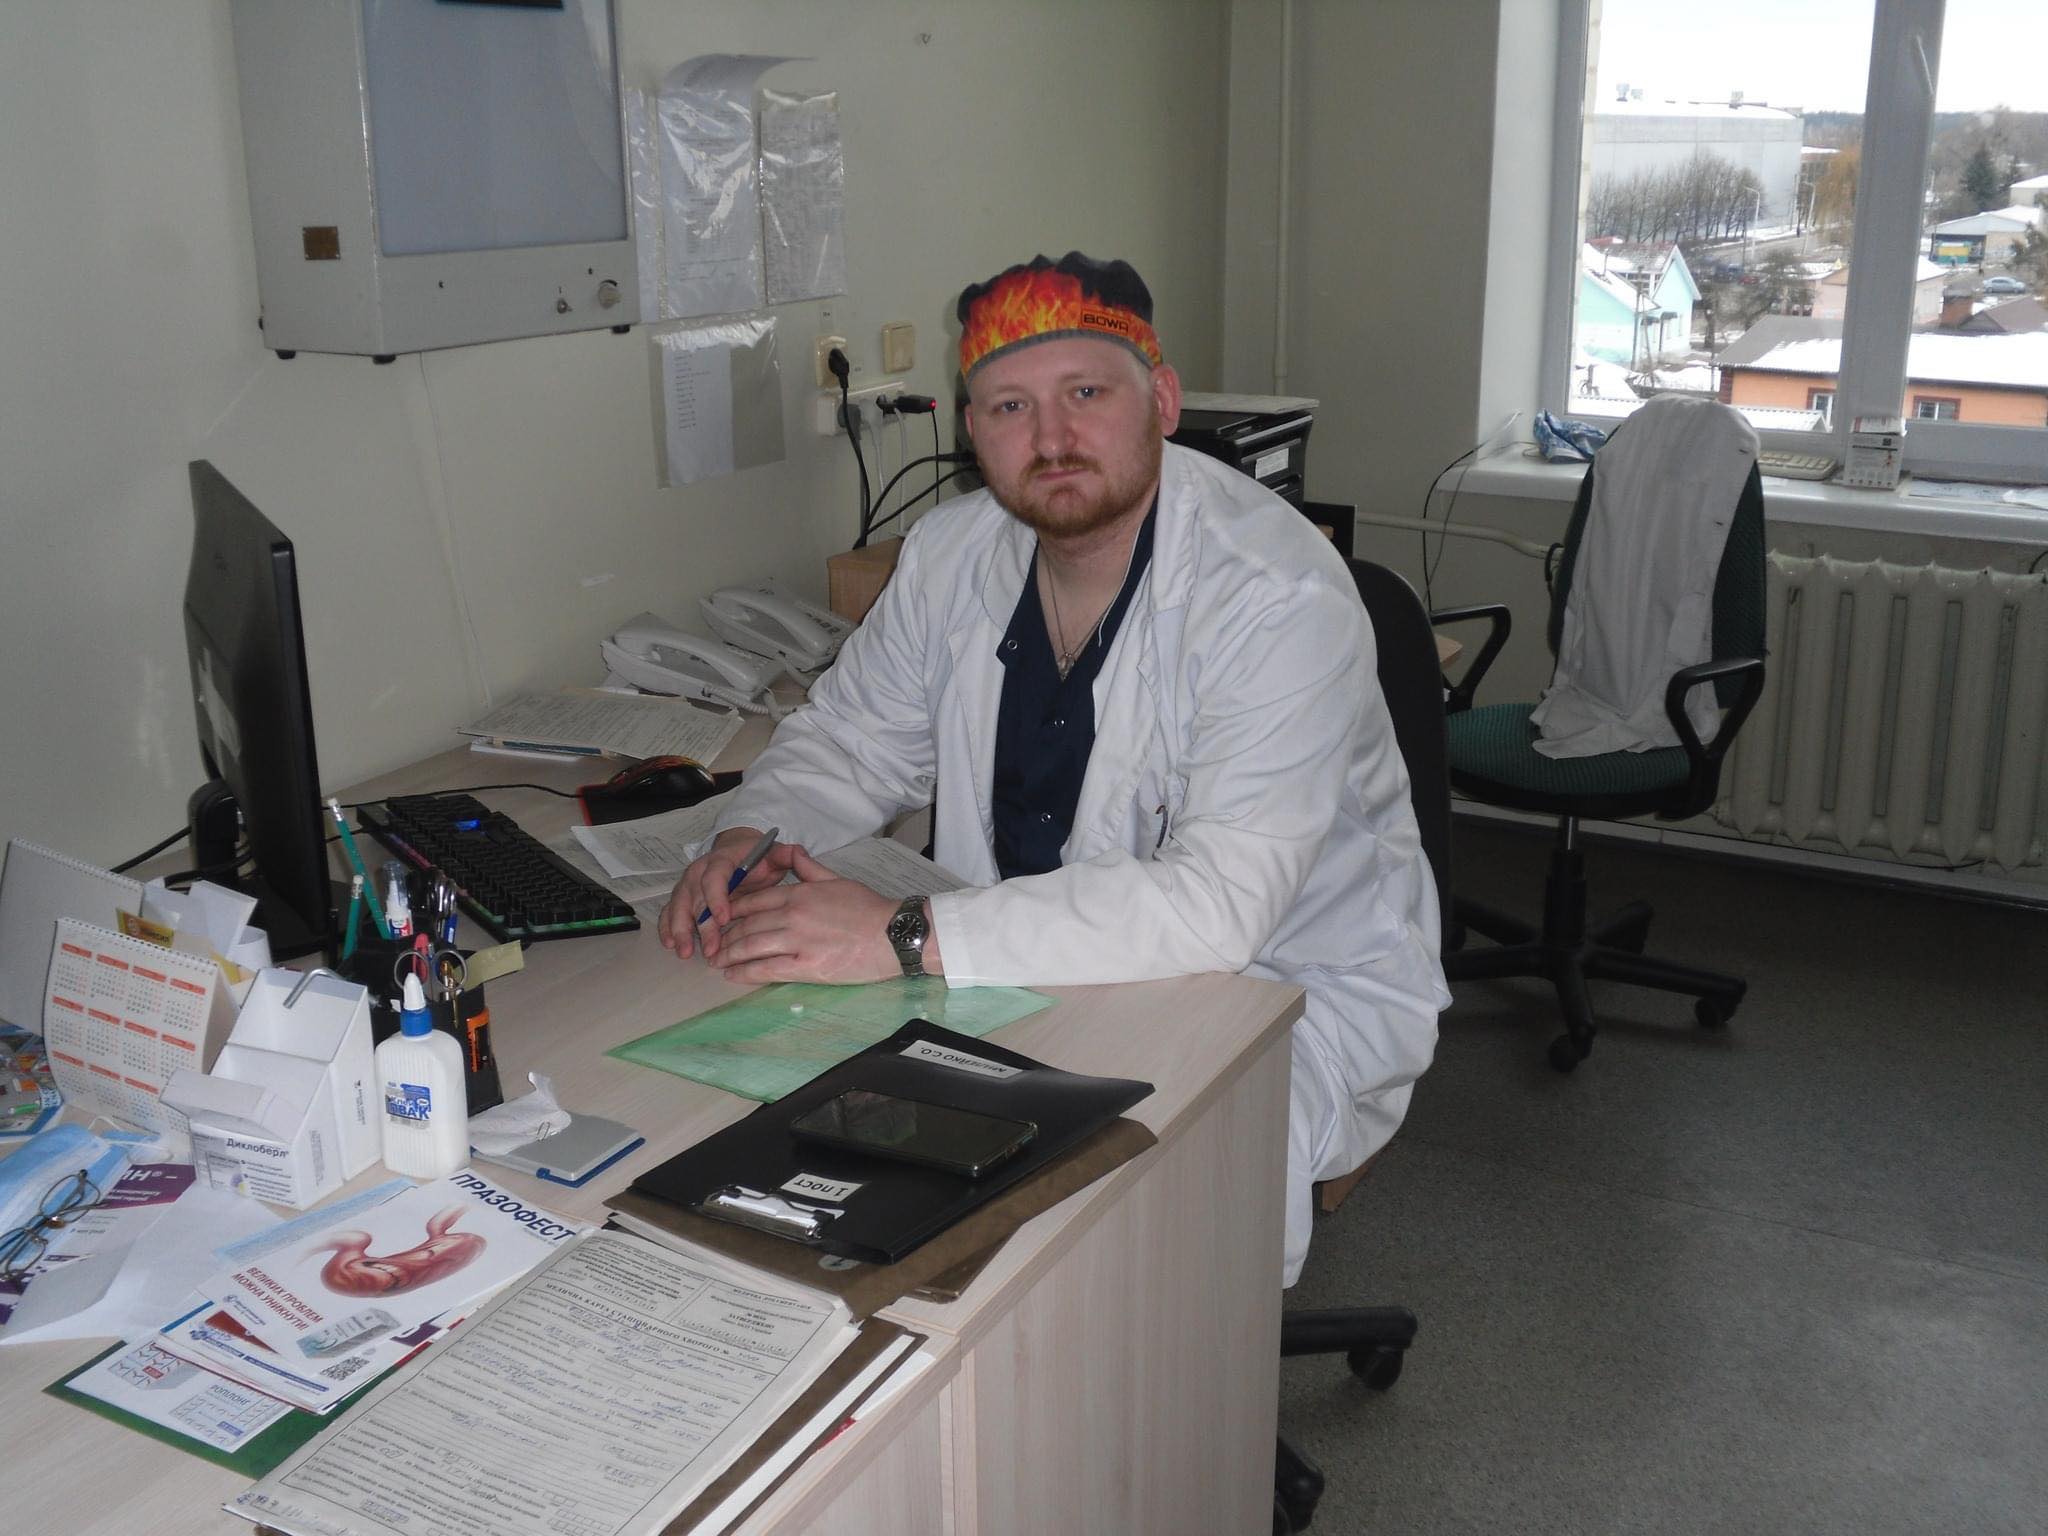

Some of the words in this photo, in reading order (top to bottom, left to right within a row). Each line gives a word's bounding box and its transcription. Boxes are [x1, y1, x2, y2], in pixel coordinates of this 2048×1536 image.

[1084, 313, 1129, 334] BOWA
[450, 1174, 577, 1242] ПРАЗОФЕСТ
[836, 1186, 849, 1197] 1
[231, 1273, 265, 1297] МОЖНА
[260, 1294, 309, 1331] УНИКНУТИ!
[246, 1266, 287, 1296] ВЕЛИКИХ
[282, 1293, 324, 1323] ПРОБЛЕМ
